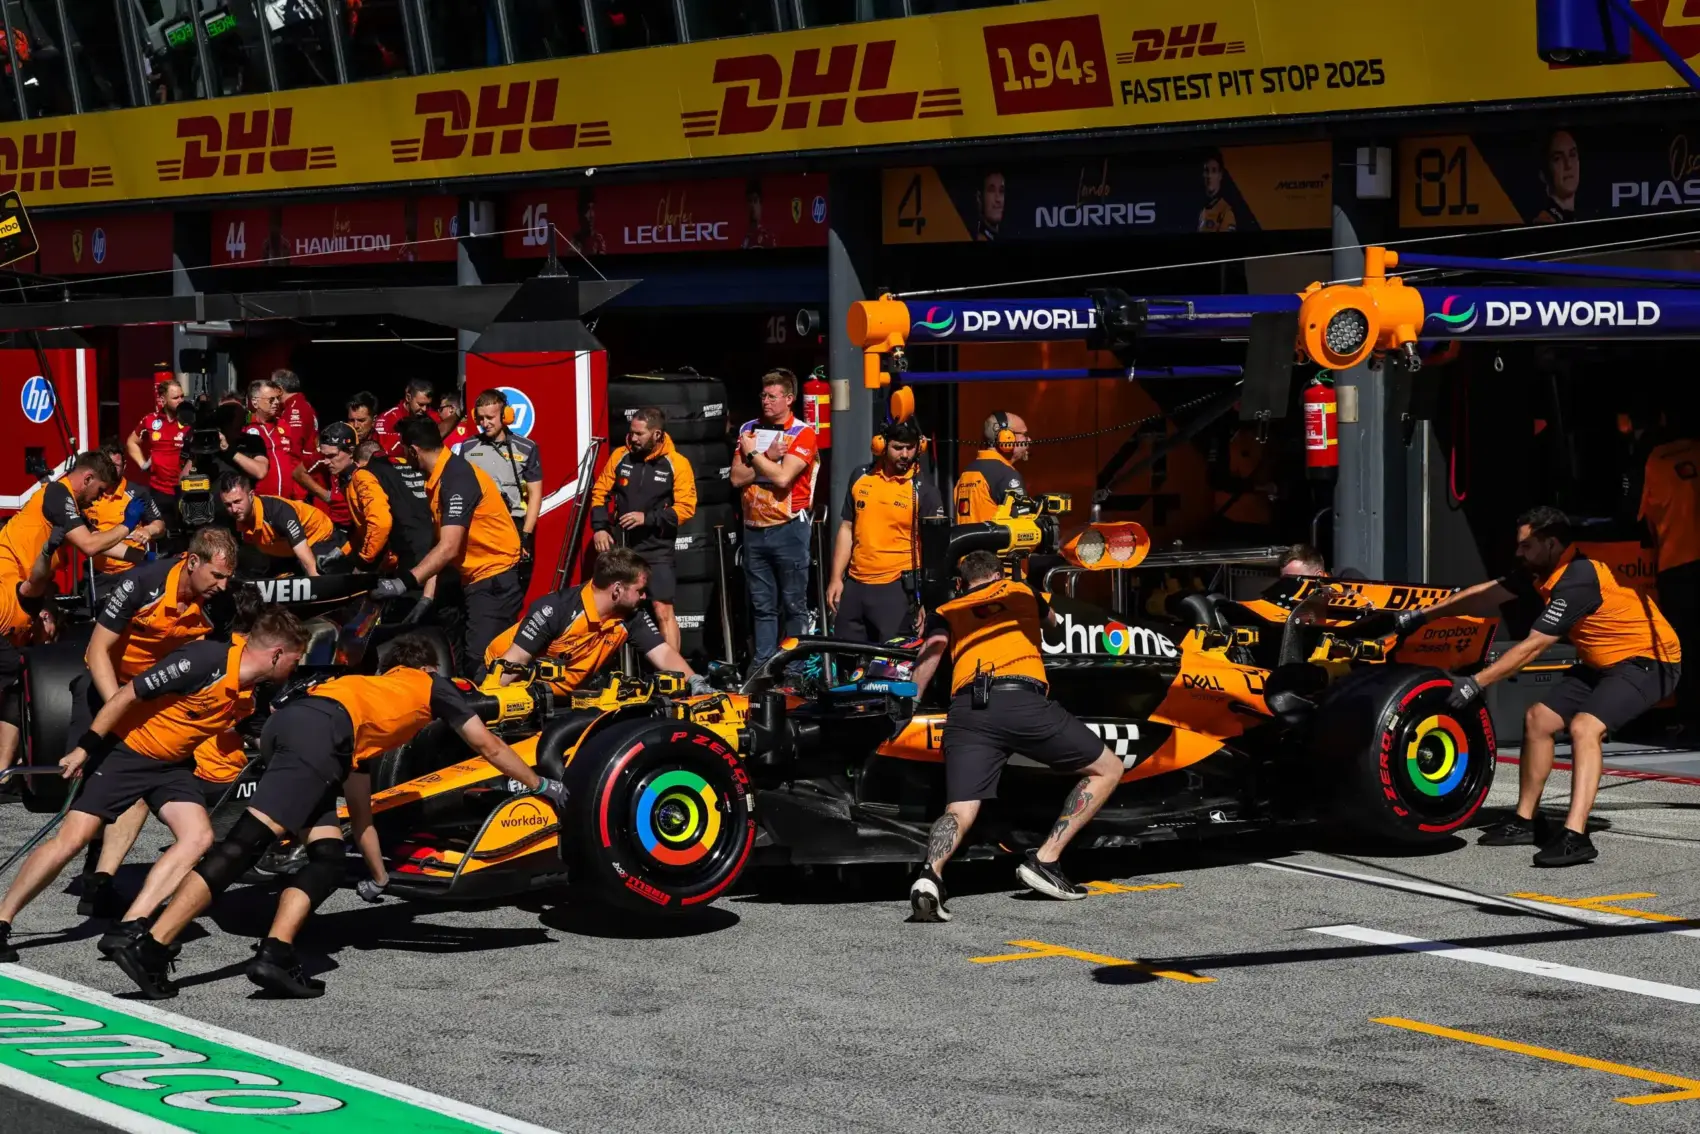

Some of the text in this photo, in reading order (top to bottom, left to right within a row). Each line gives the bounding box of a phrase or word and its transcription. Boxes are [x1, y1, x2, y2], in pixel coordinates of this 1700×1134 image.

[1132, 22, 1227, 63] DHL
[998, 39, 1097, 92] 1.94s
[1120, 58, 1385, 105] FASTEST PIT STOP 2025
[712, 39, 919, 136] DHL
[414, 78, 578, 161] DHL
[176, 107, 309, 180] DHL
[1415, 146, 1479, 216] 81
[813, 197, 825, 223] hp
[897, 171, 926, 235] 4
[1035, 202, 1156, 228] NORRIS
[226, 212, 246, 259] 44
[296, 234, 391, 255] HAMILTON
[522, 203, 549, 246] 16
[624, 221, 729, 245] LECLERC
[764, 315, 787, 344] 16
[962, 310, 1001, 332] DP
[1486, 301, 1661, 327] DP WORLD
[26, 377, 50, 422] hp
[1423, 626, 1480, 641] Dropbox
[1182, 673, 1225, 691] DELL
[691, 734, 749, 785] ZERO
[1379, 731, 1399, 801] ZERO
[501, 814, 549, 828] workday
[624, 875, 672, 906] PIRELLI
